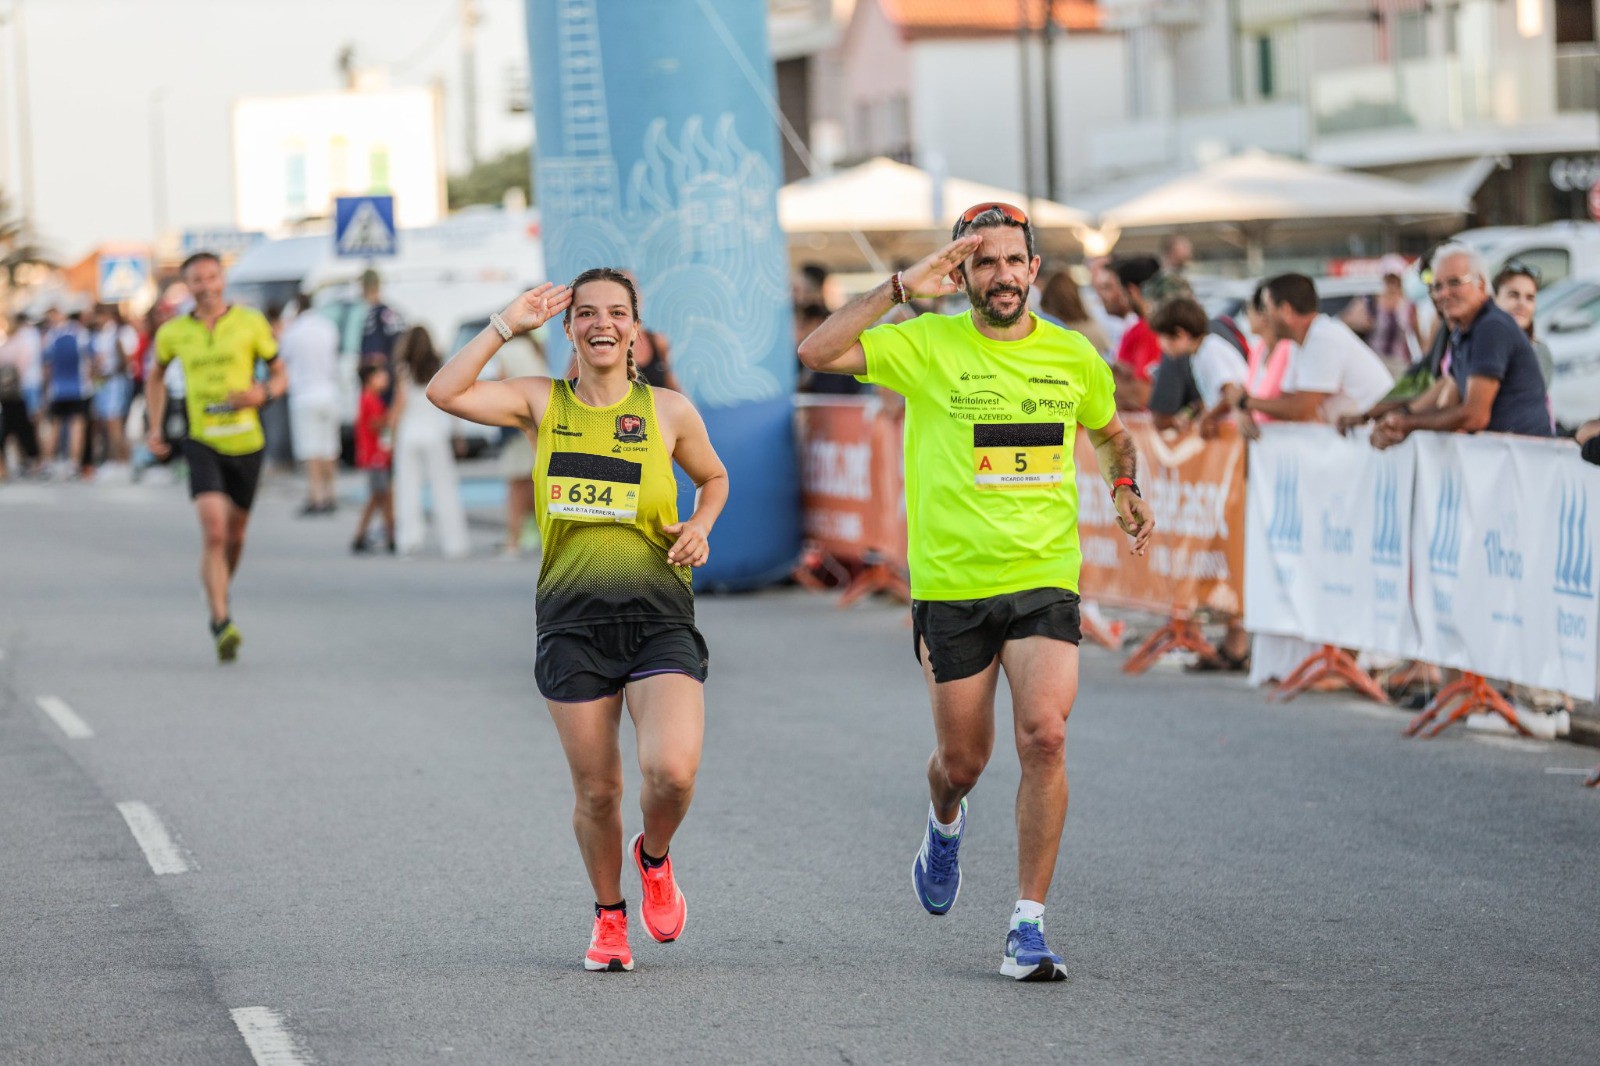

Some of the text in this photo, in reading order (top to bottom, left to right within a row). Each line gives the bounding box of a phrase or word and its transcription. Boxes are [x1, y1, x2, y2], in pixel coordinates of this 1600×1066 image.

[1039, 398, 1075, 410] PREVENT
[950, 411, 1012, 421] MIGUEL AZEVEDO
[979, 452, 1028, 472] A 5
[551, 483, 613, 506] B 634
[588, 508, 616, 517] FERREIRA
